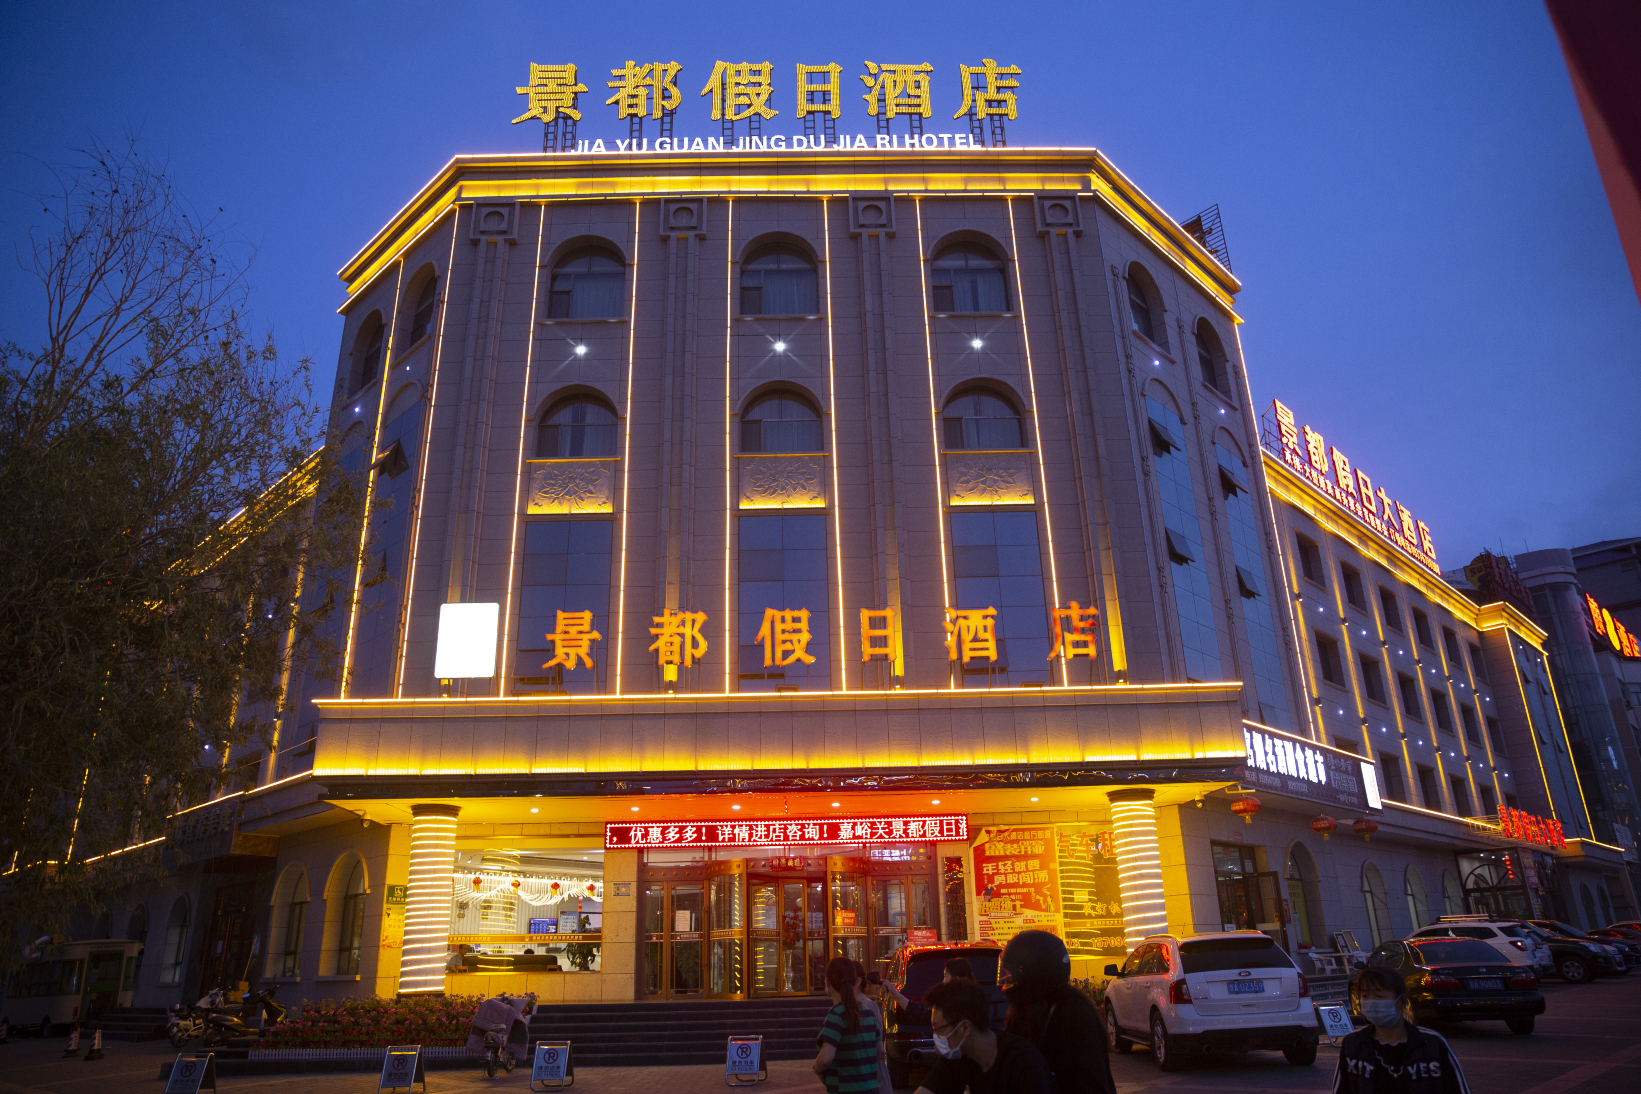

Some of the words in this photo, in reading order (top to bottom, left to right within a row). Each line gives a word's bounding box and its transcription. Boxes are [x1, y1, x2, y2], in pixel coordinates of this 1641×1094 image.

[511, 58, 1022, 124] 景都假日酒店
[571, 138, 606, 153] JIA
[615, 137, 648, 152] YU
[655, 136, 724, 151] GUAN
[732, 134, 786, 150] JING
[793, 134, 826, 150] DU
[833, 134, 869, 149] JIA
[876, 133, 898, 149] RI
[904, 133, 982, 149] HOTEL
[1273, 398, 1437, 560] 景都假日大酒店
[546, 601, 1101, 670] 景都假日酒店
[985, 841, 1046, 856] 盛装开业
[982, 859, 1040, 875] 年轻就要
[994, 870, 1049, 885] 勇敢闯荡
[1407, 1061, 1442, 1080] YES
